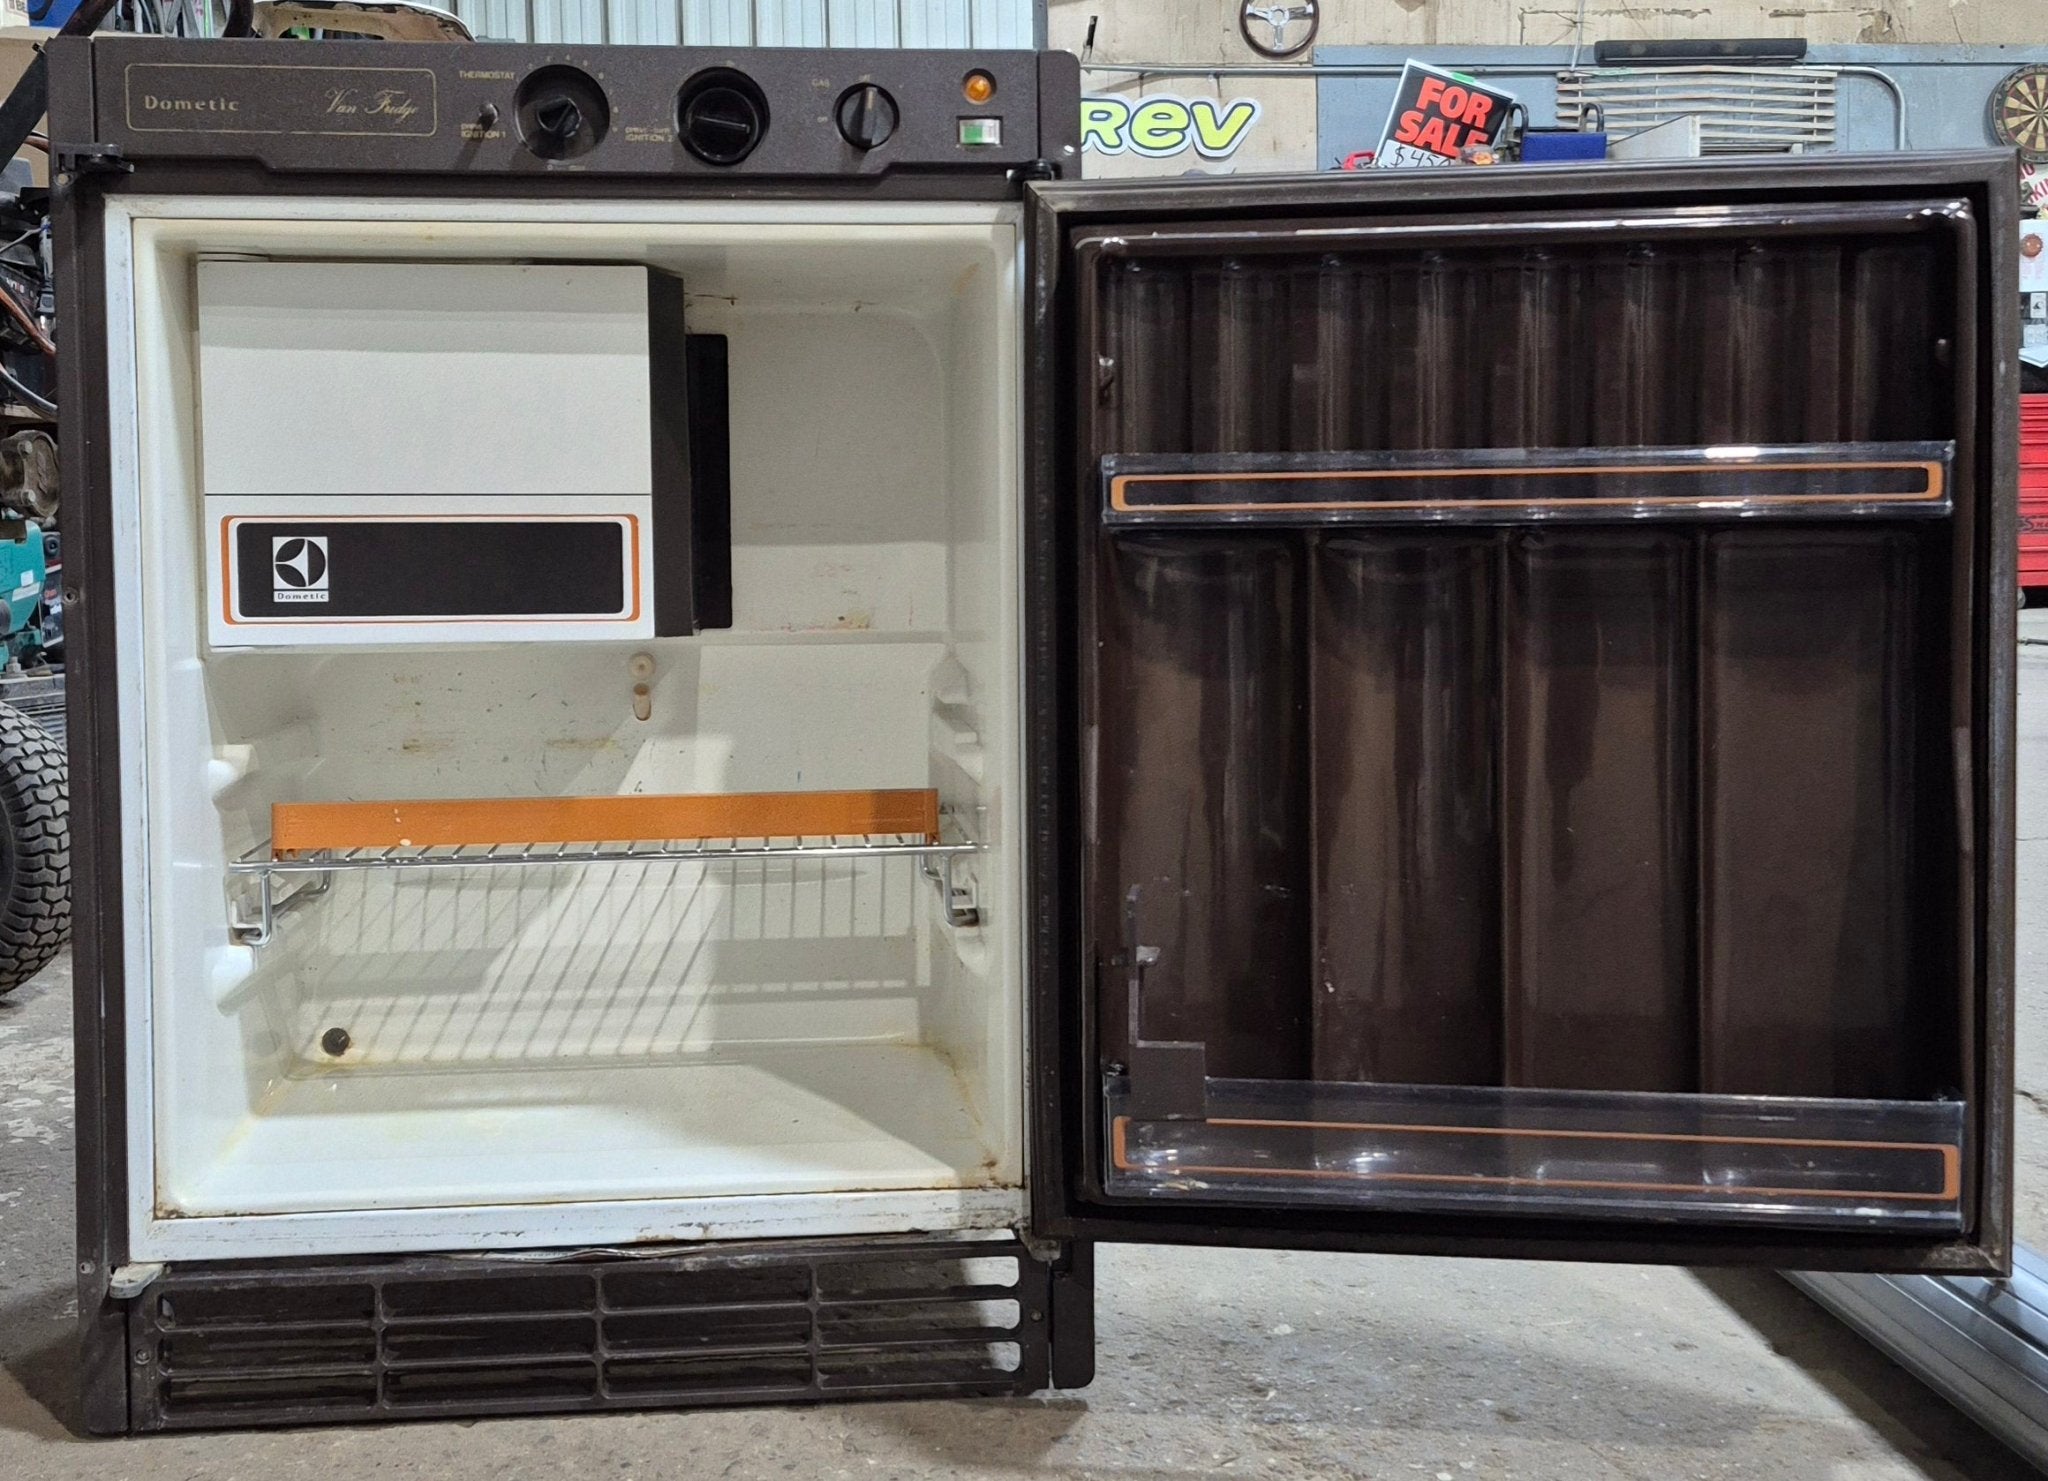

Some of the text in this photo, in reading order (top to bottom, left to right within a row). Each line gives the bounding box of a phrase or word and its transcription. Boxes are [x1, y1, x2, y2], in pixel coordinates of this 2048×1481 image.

[459, 70, 515, 80] THERMOSTAT
[144, 95, 239, 112] Dometic
[325, 87, 358, 114] Van
[1416, 76, 1493, 129] FOR
[1080, 97, 1256, 151] Rev
[625, 133, 665, 142] IGNITION
[277, 592, 326, 600] Dometic
